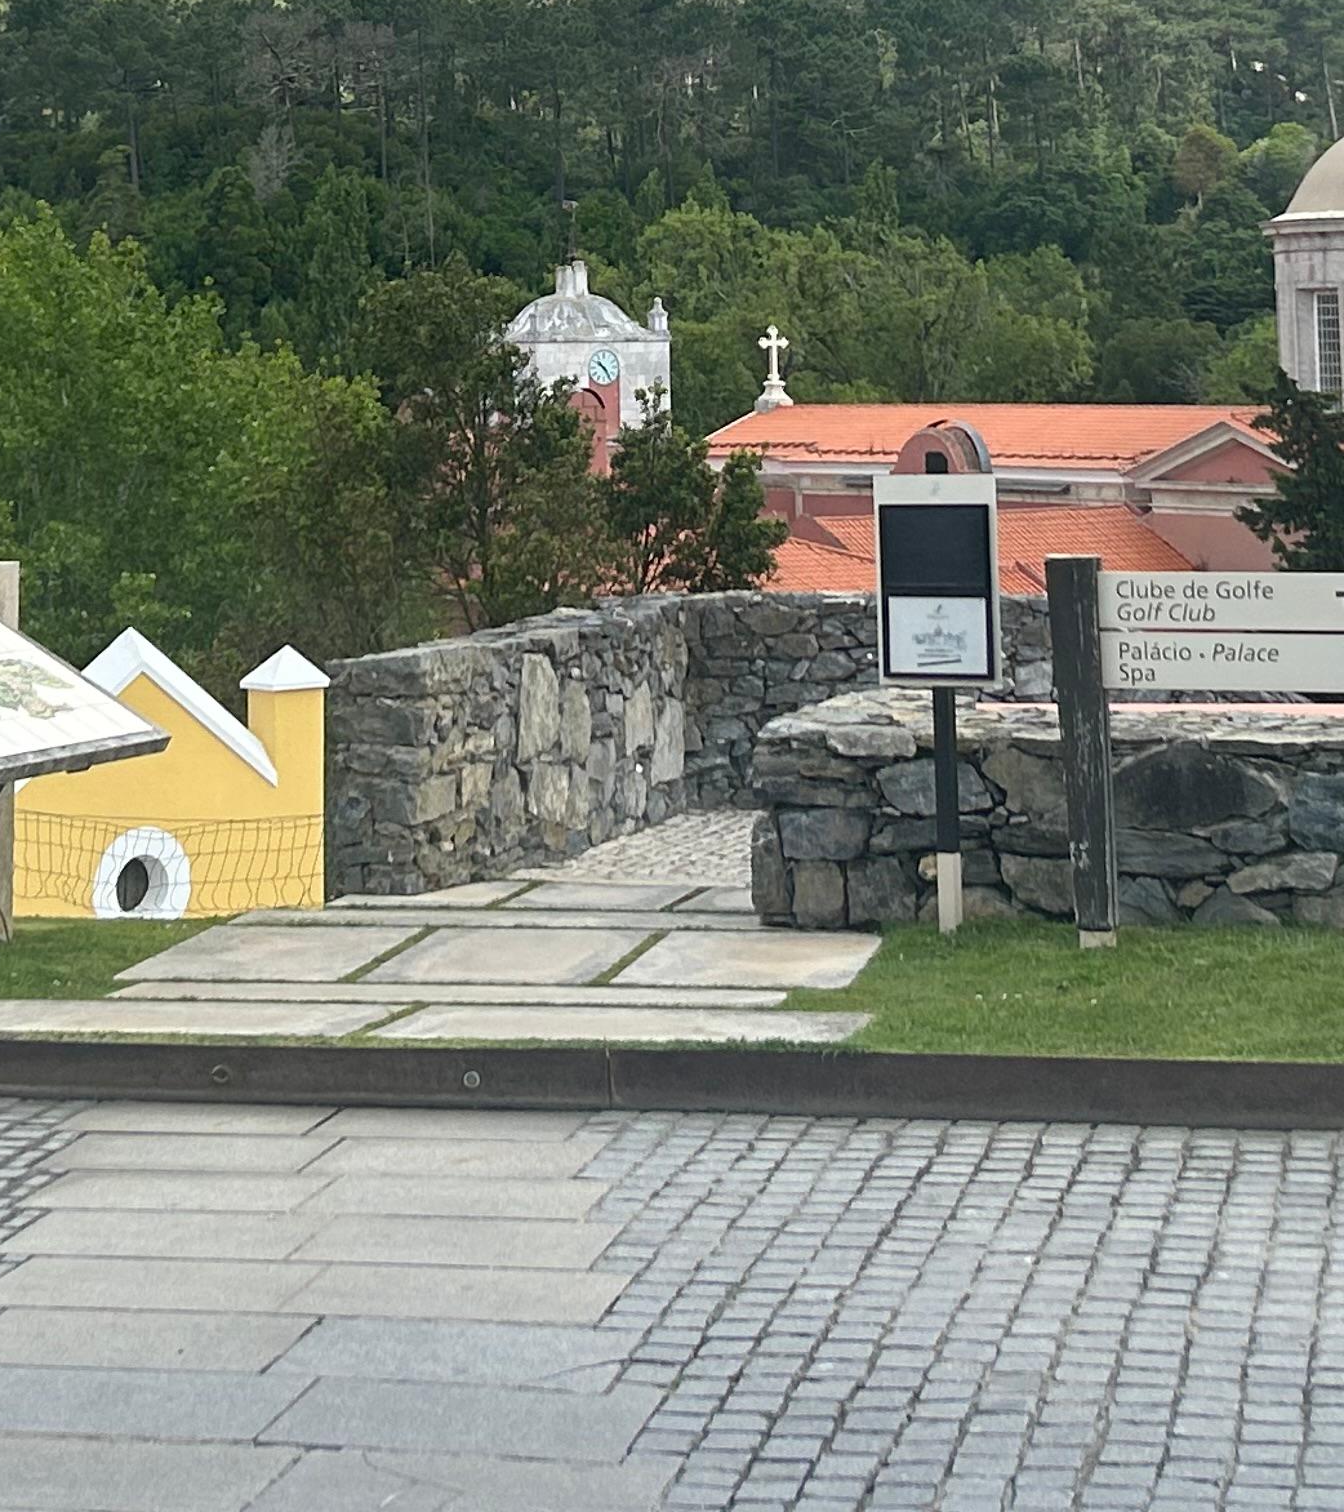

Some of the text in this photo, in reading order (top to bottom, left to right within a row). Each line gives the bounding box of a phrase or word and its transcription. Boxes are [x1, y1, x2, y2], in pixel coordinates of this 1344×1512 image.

[1116, 579, 1274, 600] Clube de Golfe
[1117, 602, 1216, 622] Golf Club
[1119, 640, 1279, 663] Palácio Palace
[1119, 663, 1156, 686] Spa
